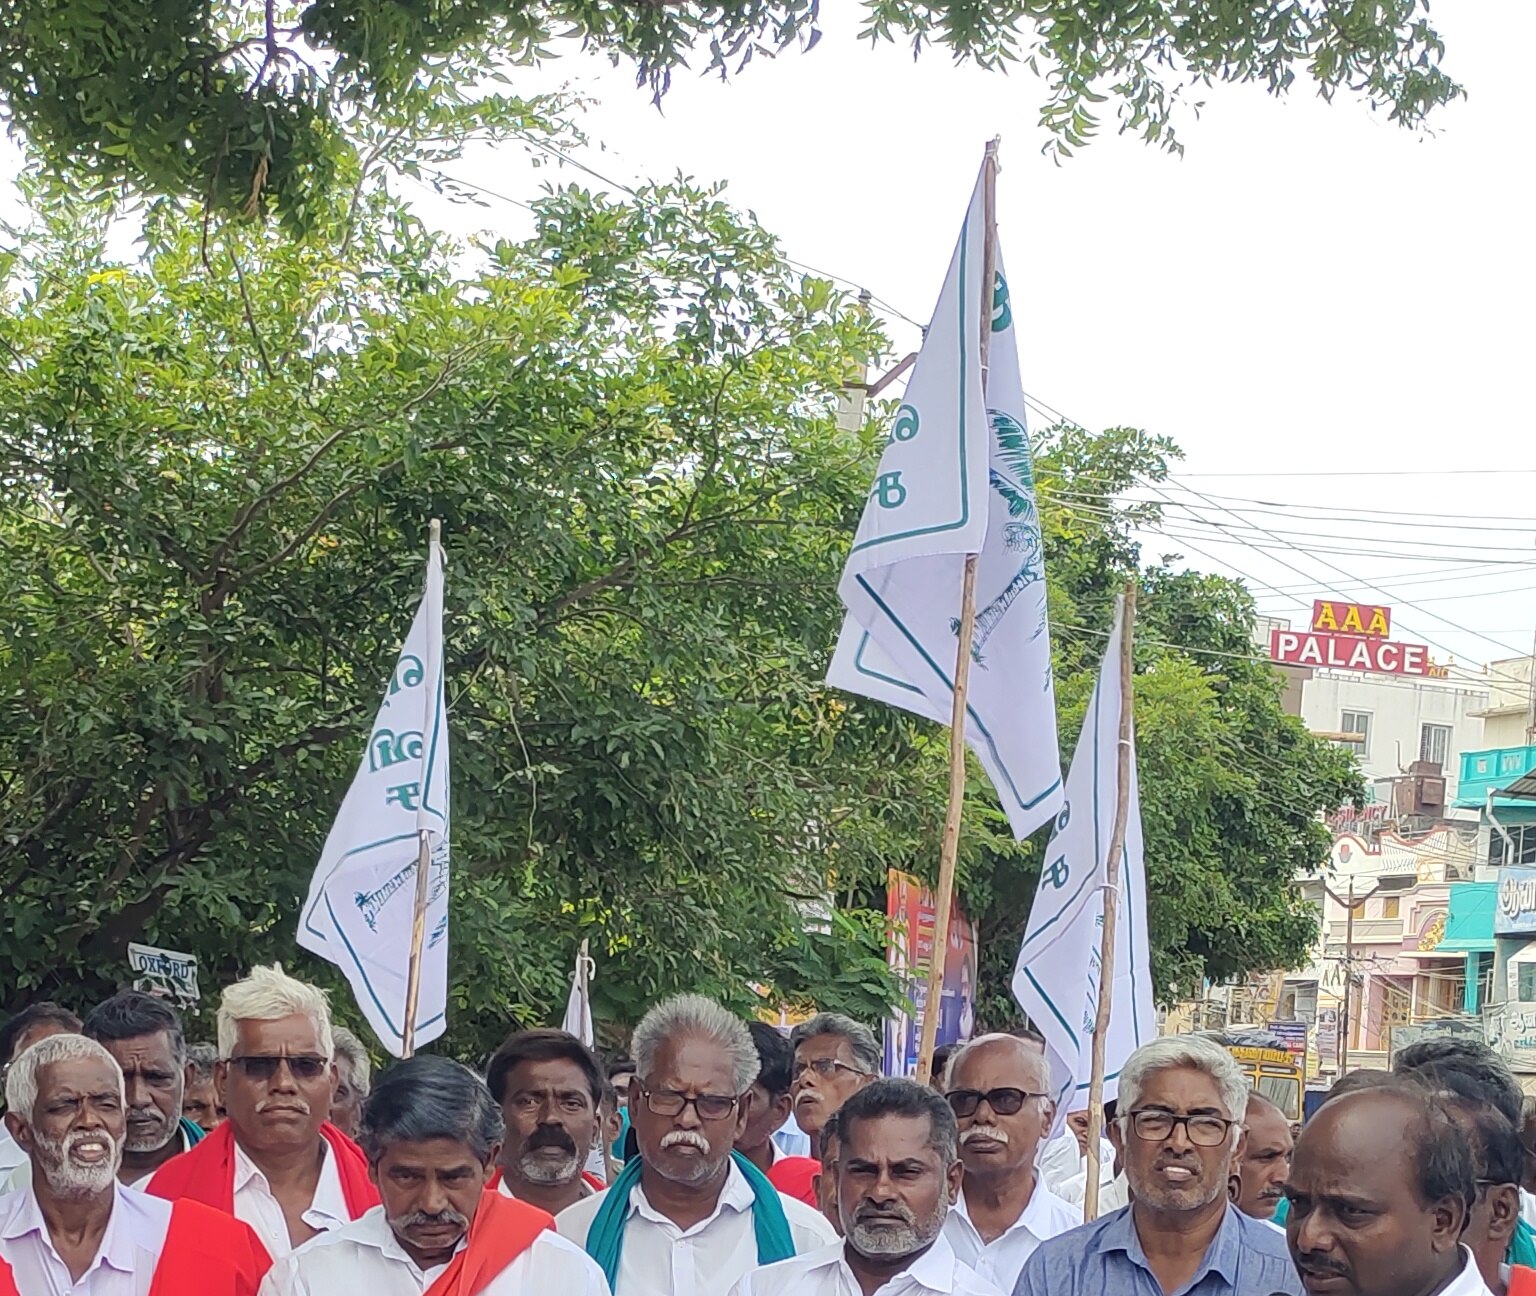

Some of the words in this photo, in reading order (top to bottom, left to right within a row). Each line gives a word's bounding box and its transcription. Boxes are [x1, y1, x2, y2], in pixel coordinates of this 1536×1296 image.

[1314, 602, 1388, 636] AAA
[1278, 633, 1424, 674] PALACE
[139, 955, 189, 978] OXFORD
